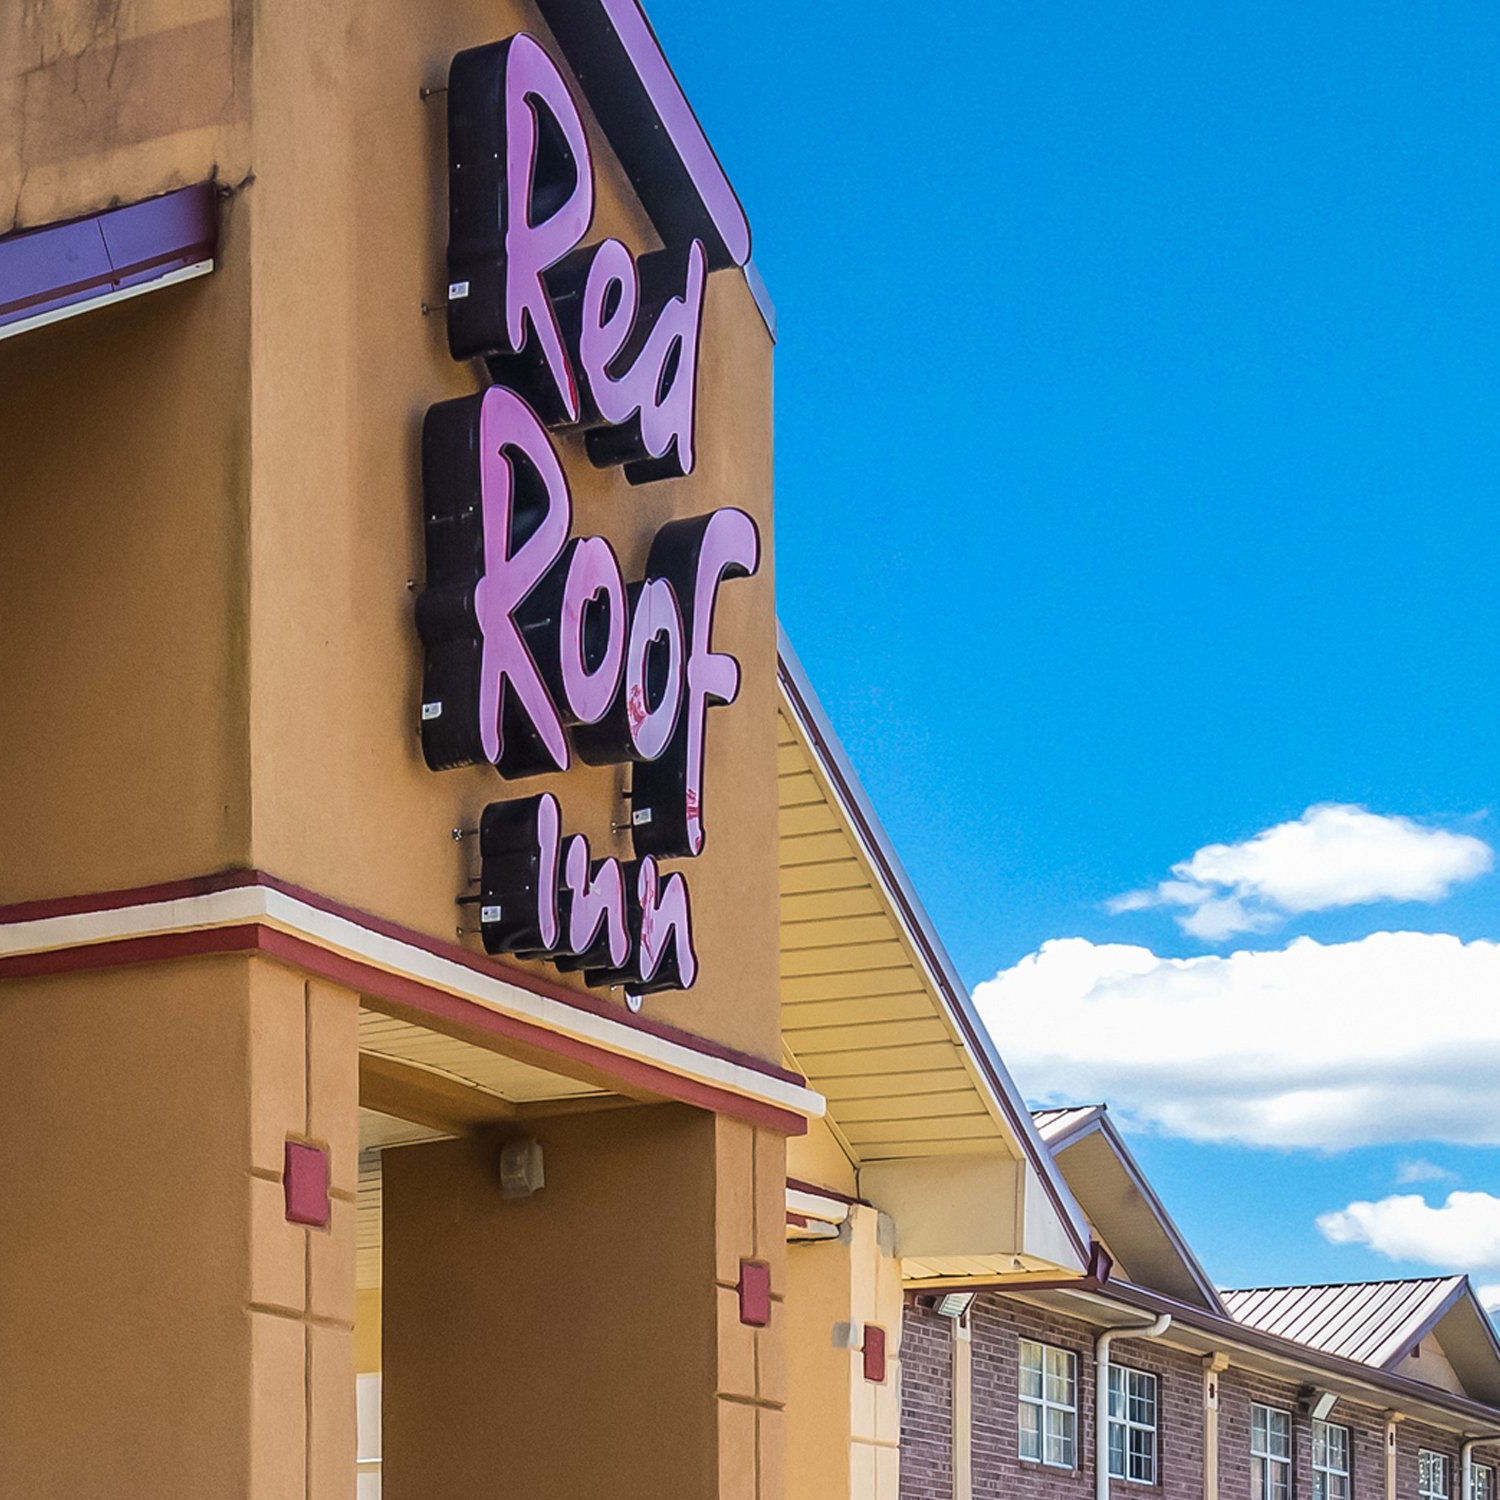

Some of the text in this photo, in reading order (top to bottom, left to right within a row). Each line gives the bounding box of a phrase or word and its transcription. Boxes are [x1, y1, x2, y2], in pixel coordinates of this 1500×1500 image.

[504, 31, 709, 477] Red
[474, 383, 760, 857] Roof
[536, 791, 698, 991] Inn
